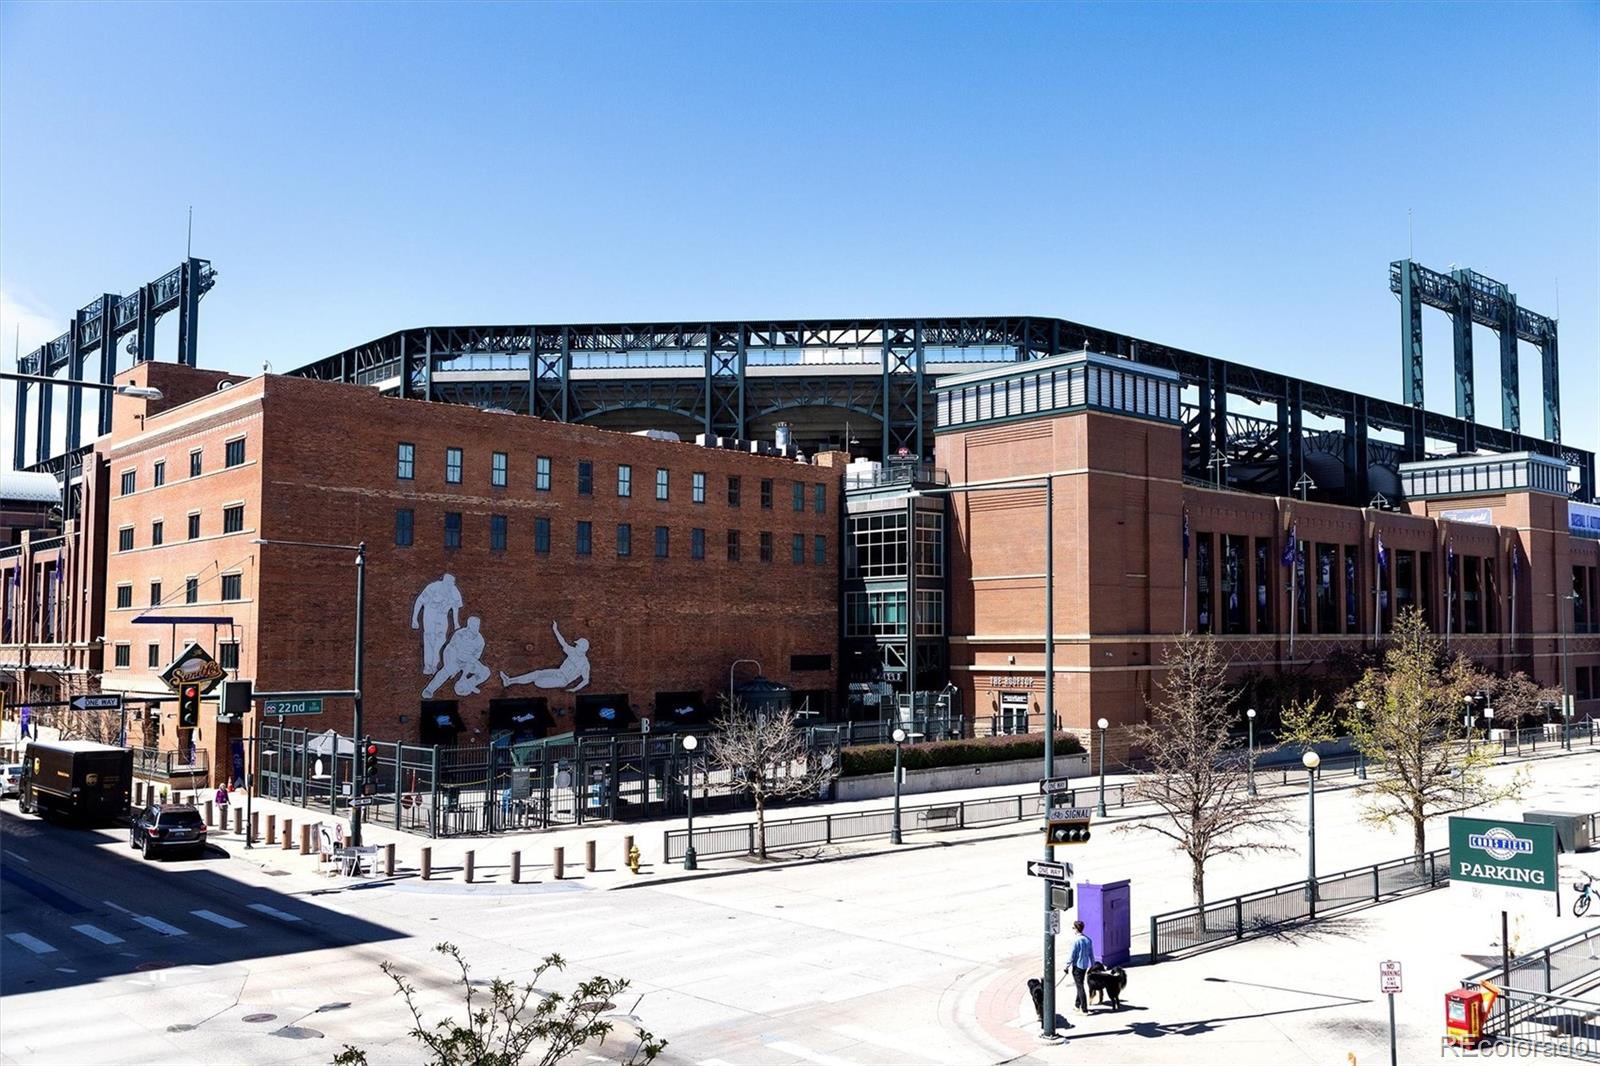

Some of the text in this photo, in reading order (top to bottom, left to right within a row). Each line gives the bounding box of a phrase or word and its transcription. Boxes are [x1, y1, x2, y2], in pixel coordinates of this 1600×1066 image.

[85, 698, 116, 706] ONE WAY
[278, 702, 305, 713] 22nd
[641, 718, 650, 733] B
[1064, 809, 1089, 819] SIGNAL
[1503, 840, 1530, 851] FIELD
[1038, 866, 1049, 874] ONE
[1460, 862, 1545, 884] PARKING
